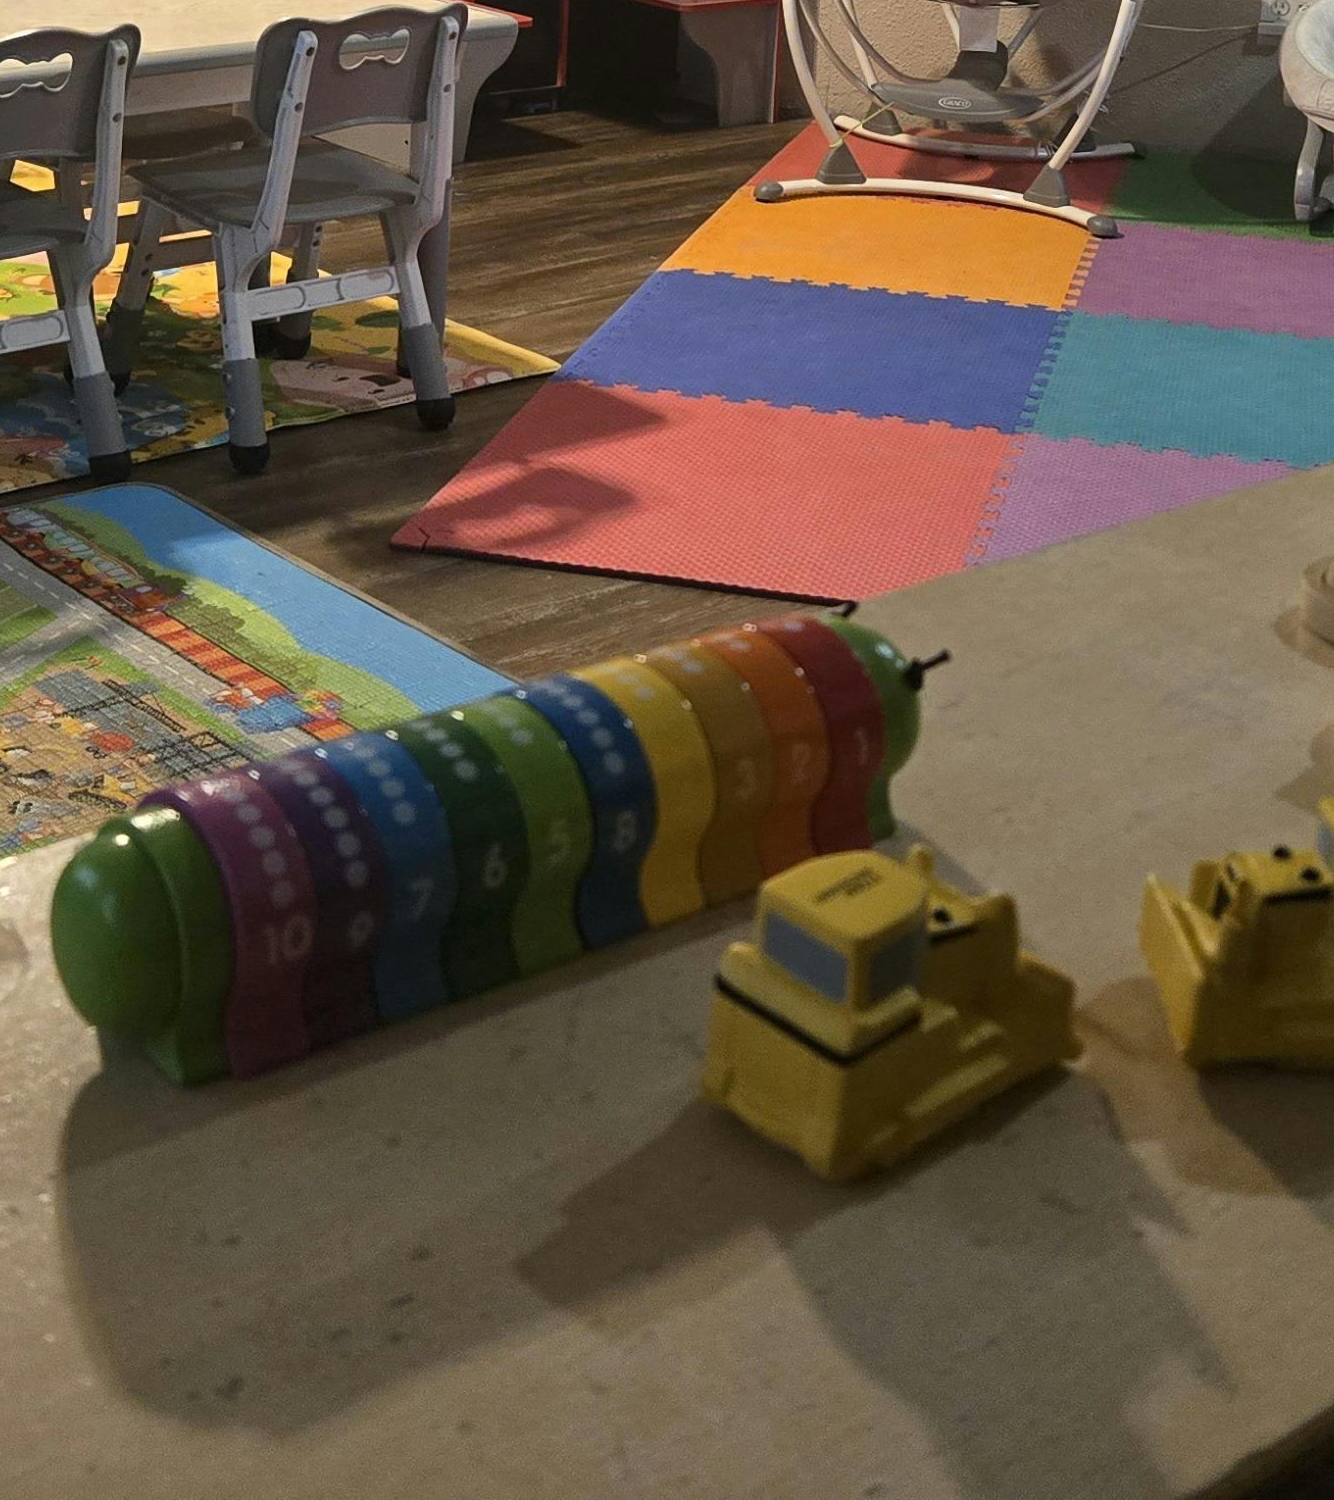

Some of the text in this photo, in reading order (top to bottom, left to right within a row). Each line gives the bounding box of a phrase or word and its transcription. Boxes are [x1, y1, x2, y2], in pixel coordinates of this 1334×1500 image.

[616, 809, 638, 852] 8
[482, 843, 508, 889] 6
[266, 914, 313, 965] 10
